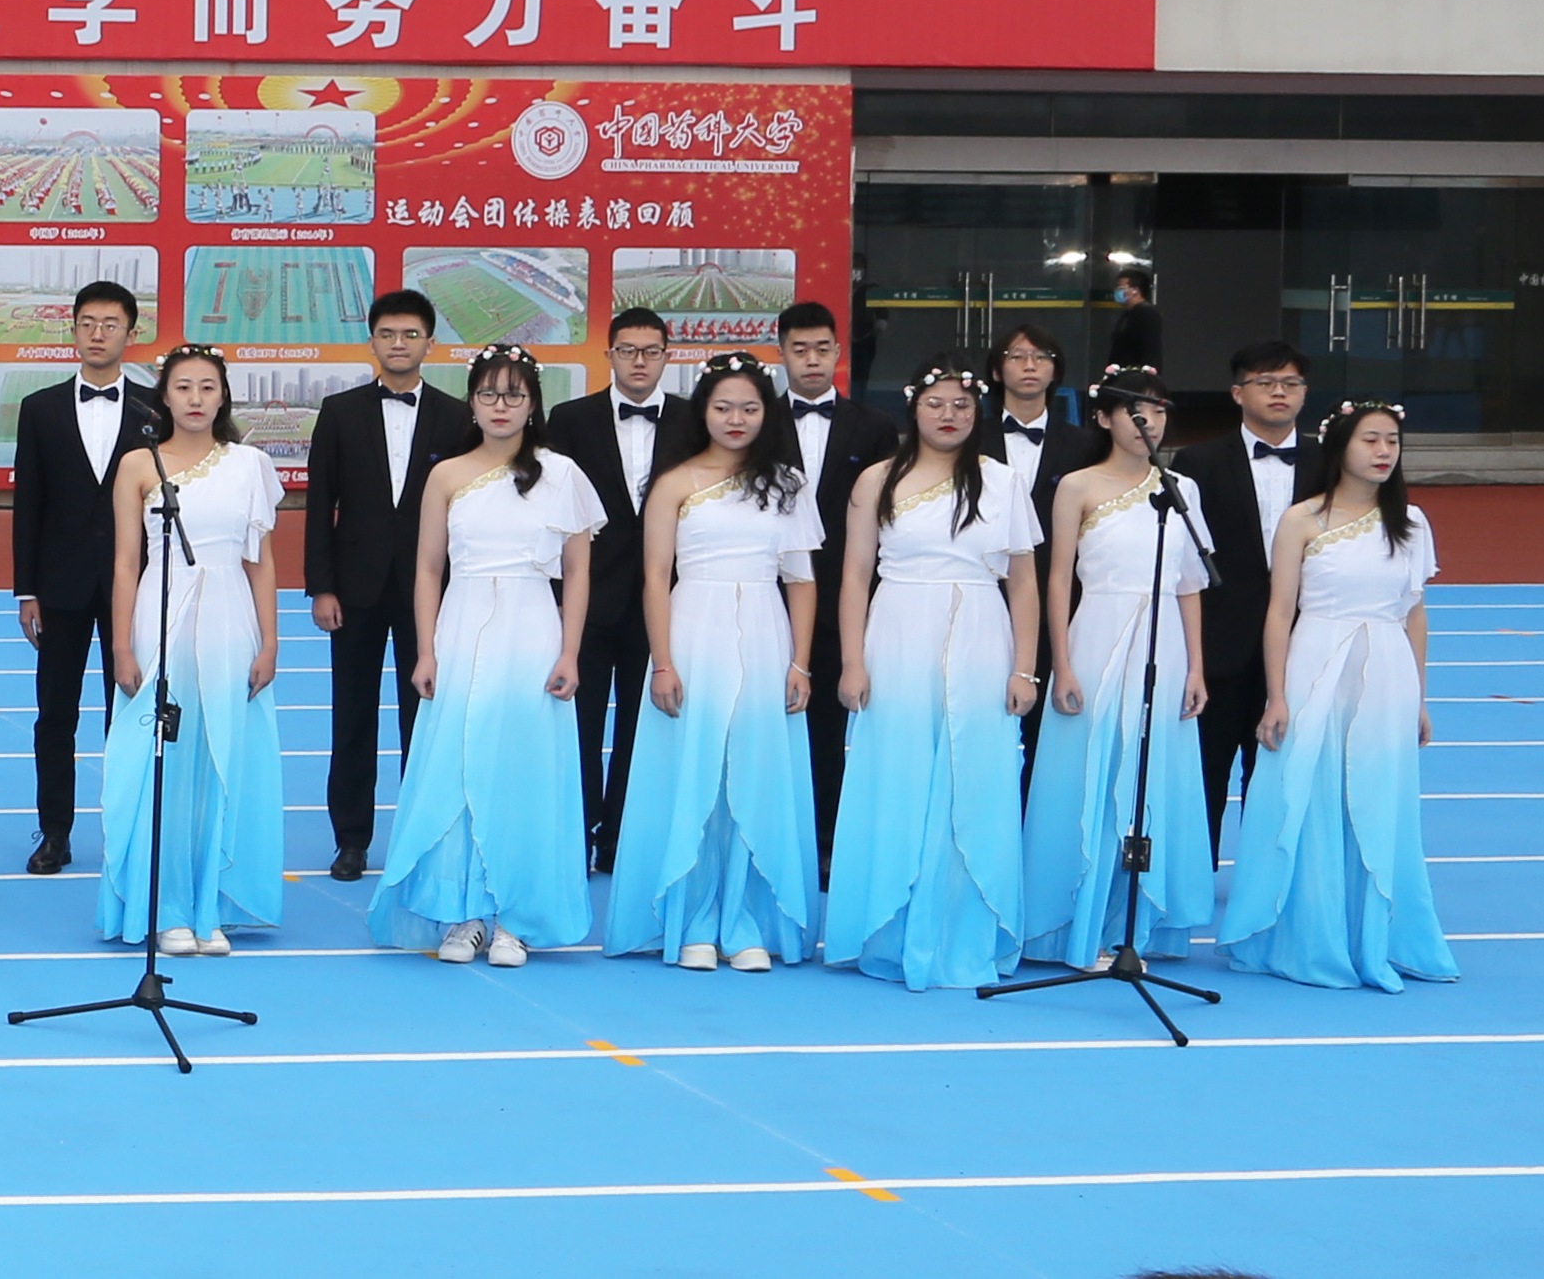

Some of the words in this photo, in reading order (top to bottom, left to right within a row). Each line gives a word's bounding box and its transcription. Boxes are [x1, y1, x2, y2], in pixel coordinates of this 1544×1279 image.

[595, 104, 803, 158] 中国药科大学
[601, 159, 637, 171] CHINA
[638, 160, 734, 172] PHARMACEUTICAL
[735, 161, 800, 173] UNIVERSITY
[384, 195, 695, 230] 运动会团体操表演回顾
